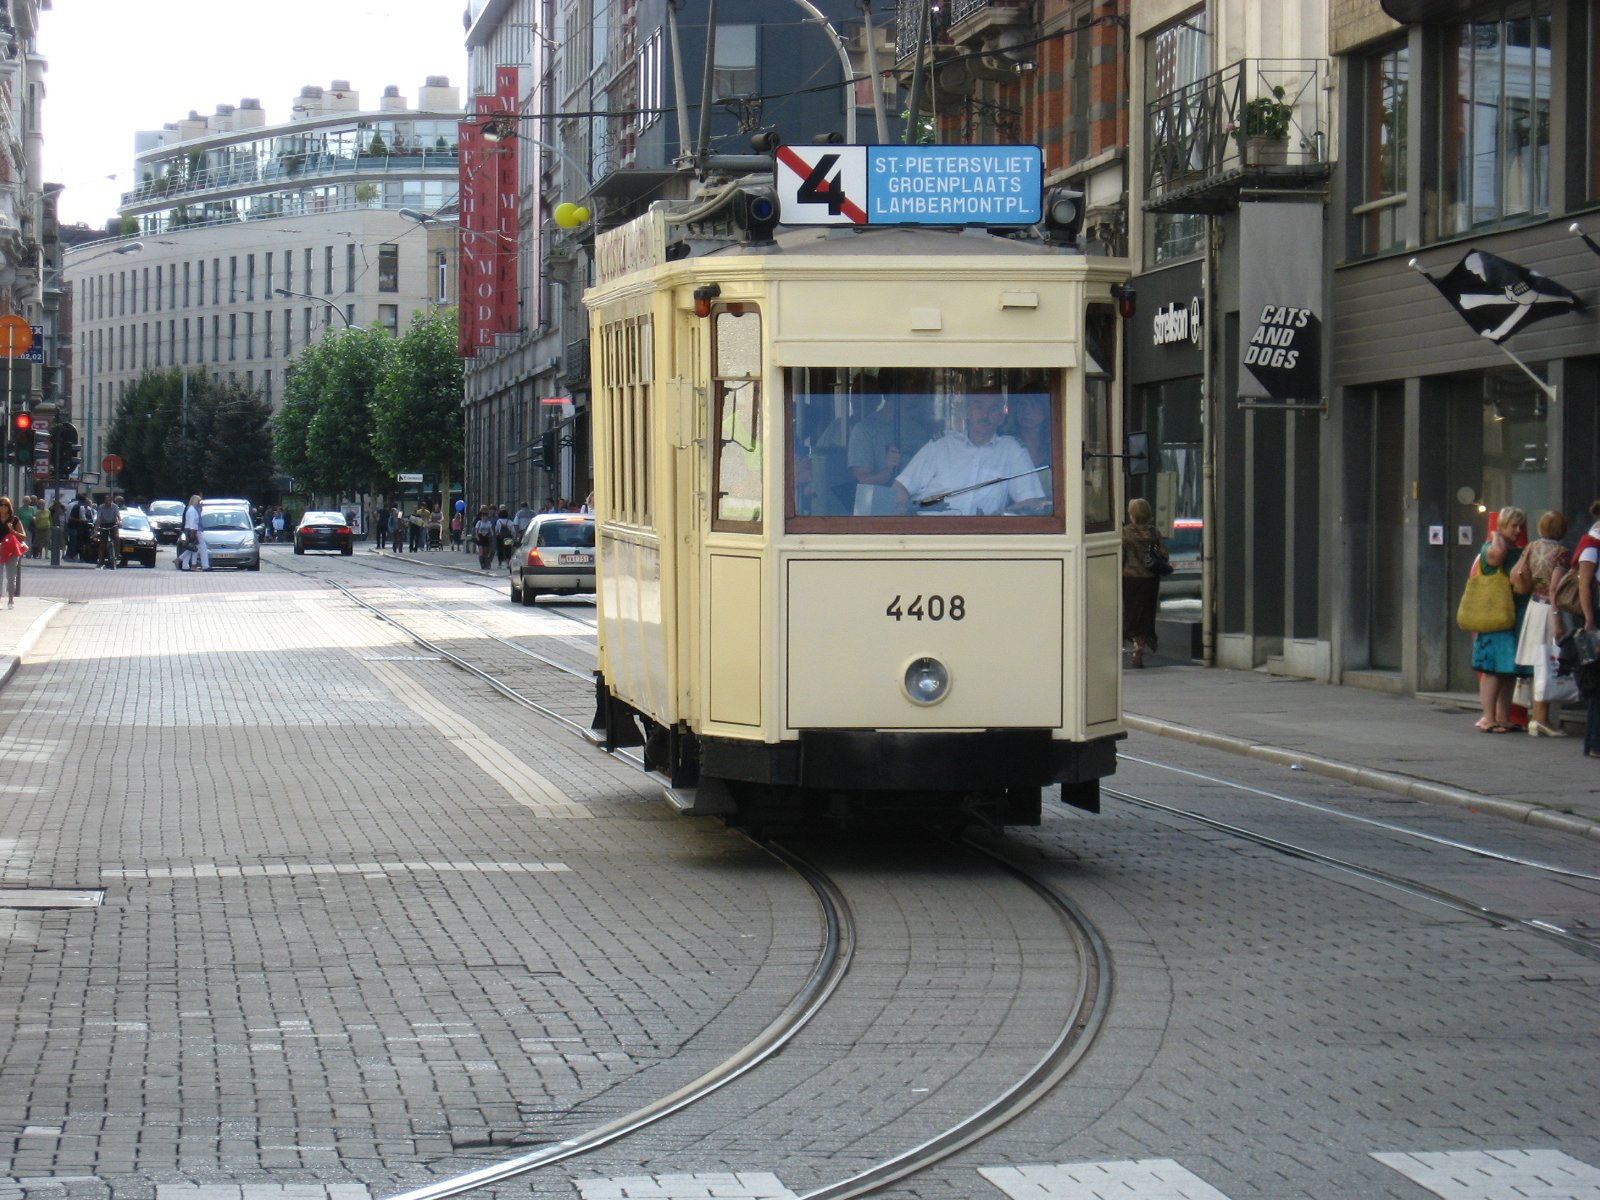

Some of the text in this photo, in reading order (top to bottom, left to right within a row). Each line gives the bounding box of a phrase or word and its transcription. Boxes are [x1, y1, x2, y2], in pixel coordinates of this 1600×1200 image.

[797, 154, 845, 215] 4
[888, 177, 1021, 193] GROENPLAATS
[462, 150, 475, 260] FASHION
[876, 197, 1034, 213] LAMBERMONTPL.
[478, 260, 493, 344] MODE
[1261, 304, 1311, 328] CATS
[1250, 325, 1295, 347] AND
[1244, 345, 1299, 369] DOGS
[886, 594, 966, 621] 4408
